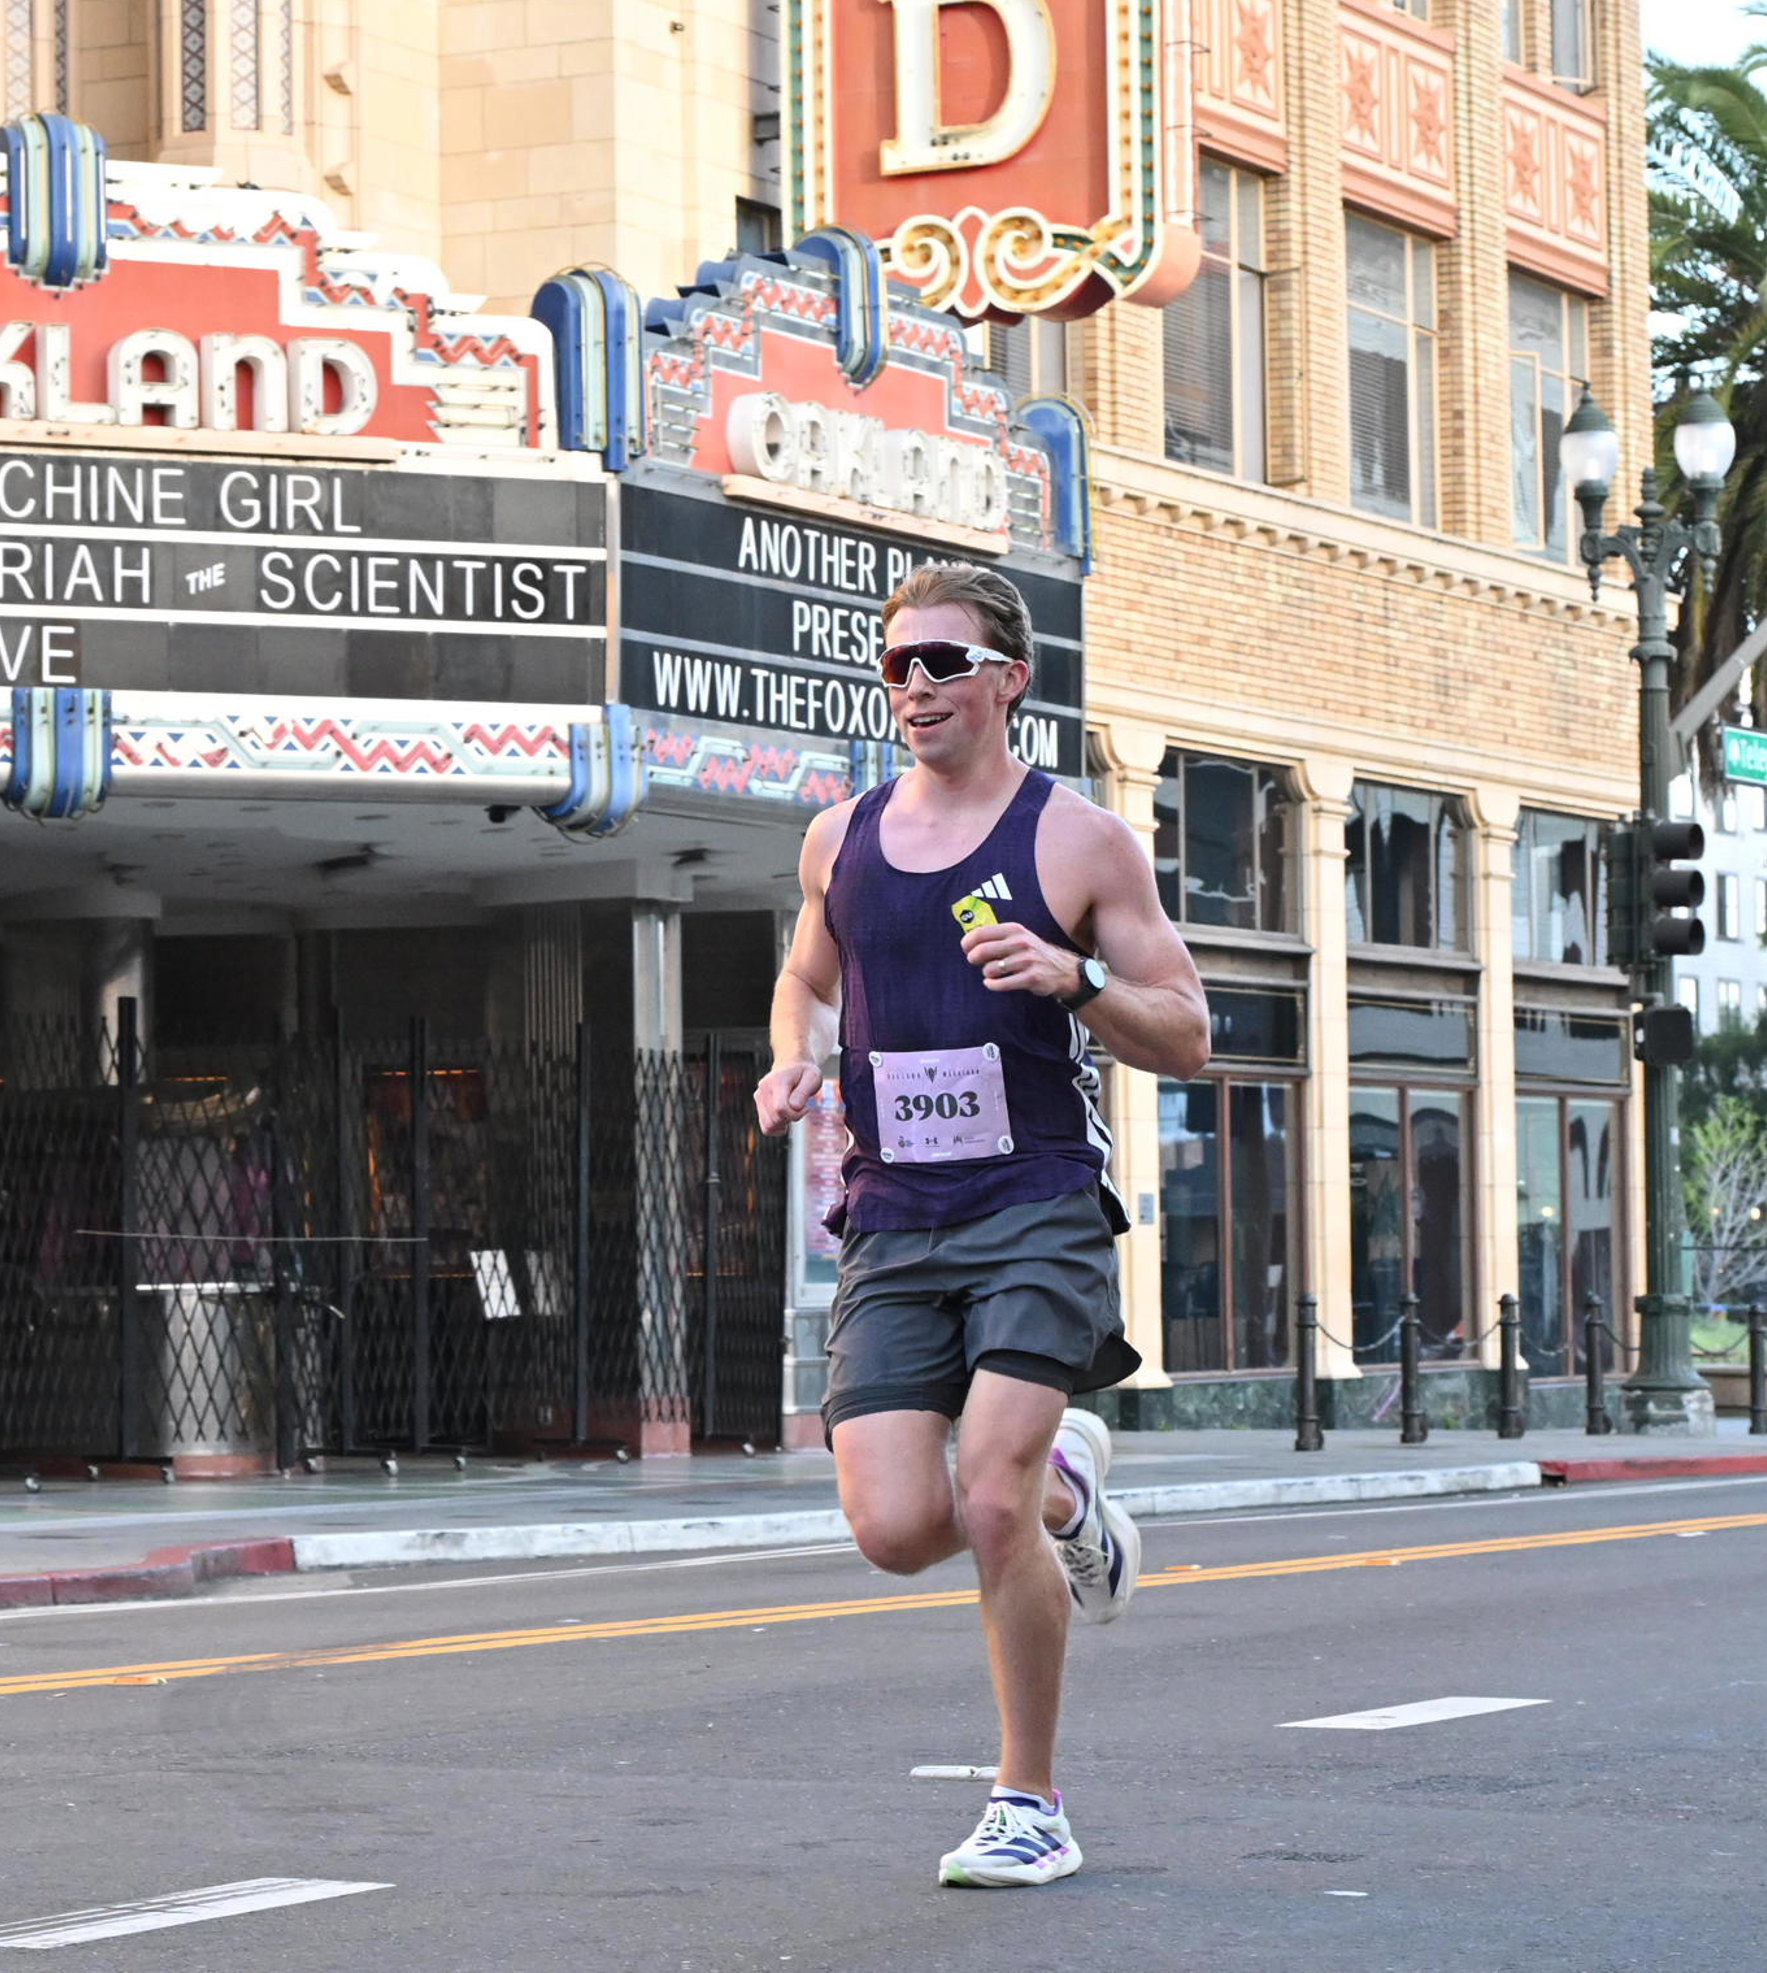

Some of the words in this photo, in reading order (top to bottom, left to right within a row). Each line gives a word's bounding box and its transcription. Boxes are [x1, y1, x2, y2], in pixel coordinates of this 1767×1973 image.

[880, 0, 1057, 177] D
[0, 460, 187, 525] CHINE
[219, 470, 362, 533] GIRL
[726, 391, 1007, 532] OAKLAND
[0, 542, 151, 604] RIAH
[185, 562, 226, 595] THE
[260, 551, 587, 620] SCIENTIST
[738, 516, 877, 593] ANOTHER
[0, 624, 77, 684] VE
[793, 600, 884, 667] PRESE
[894, 1091, 981, 1122] 3903
